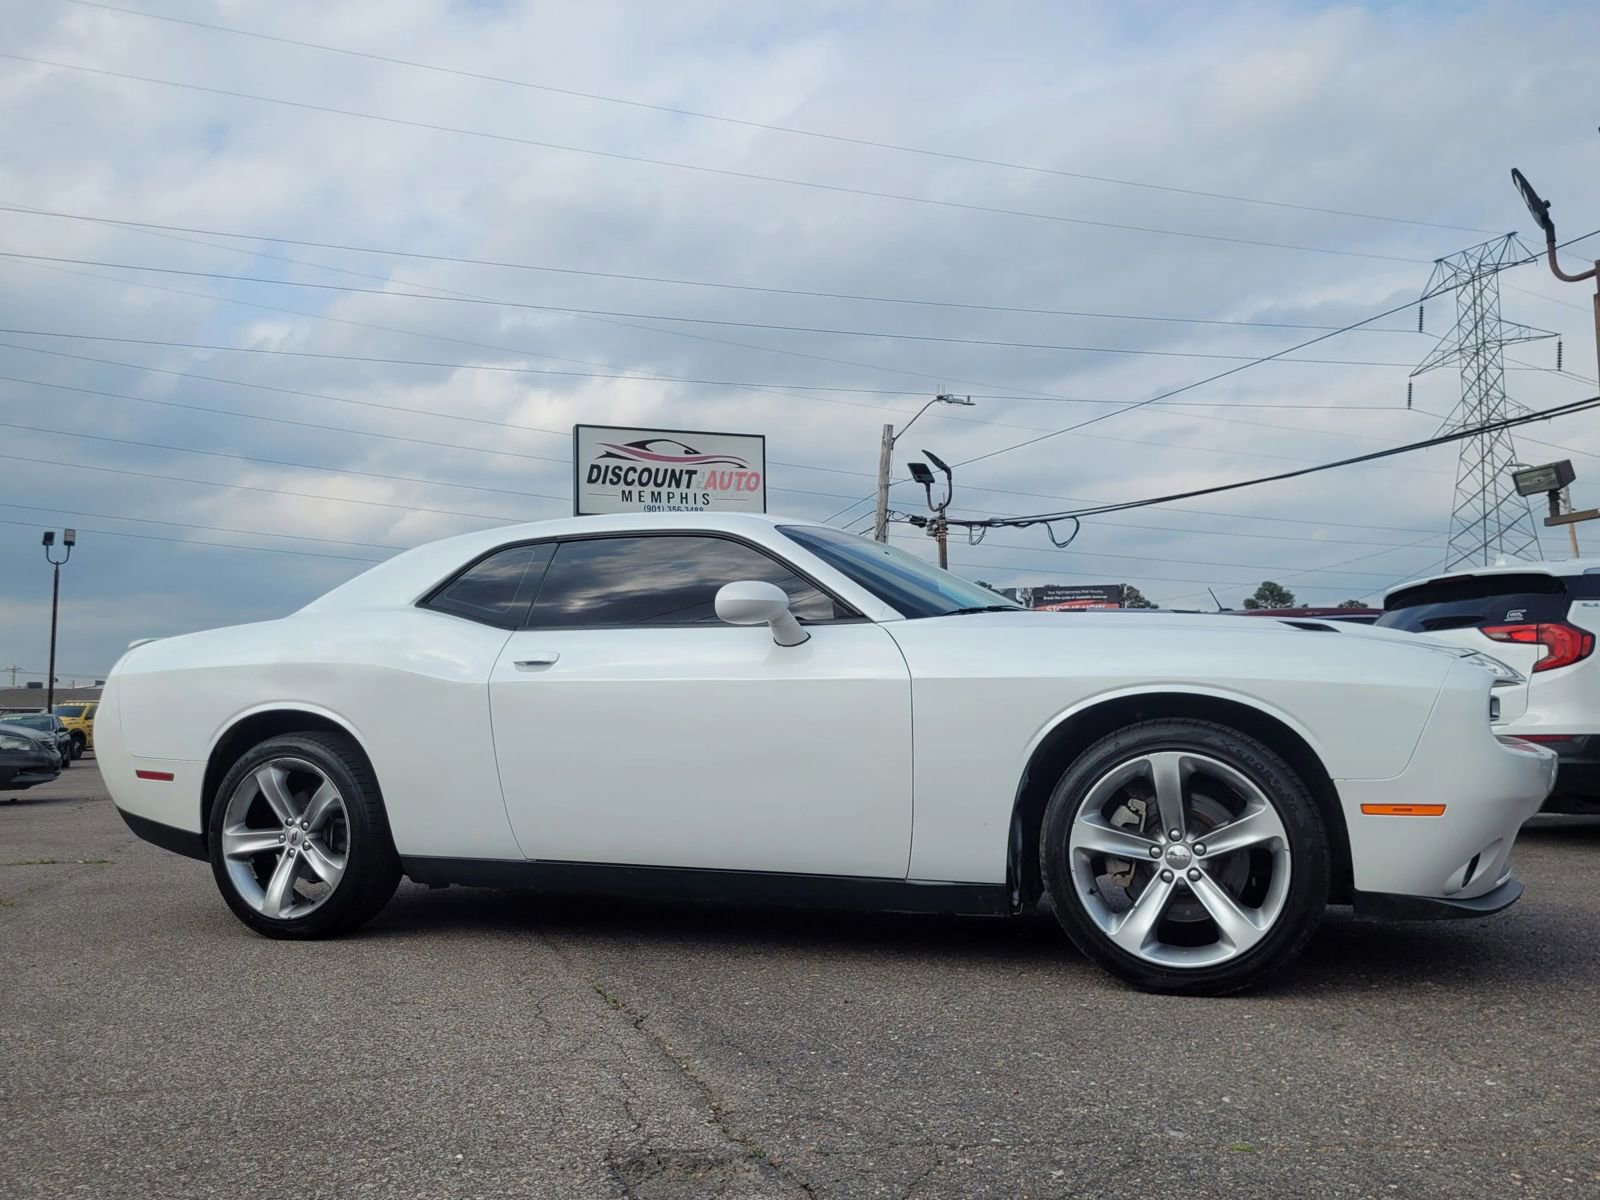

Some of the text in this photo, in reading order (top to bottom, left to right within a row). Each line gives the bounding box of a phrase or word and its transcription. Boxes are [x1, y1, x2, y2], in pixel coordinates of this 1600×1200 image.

[586, 463, 761, 492] DISCOUNT AUTO
[621, 489, 711, 505] MEMPHIS
